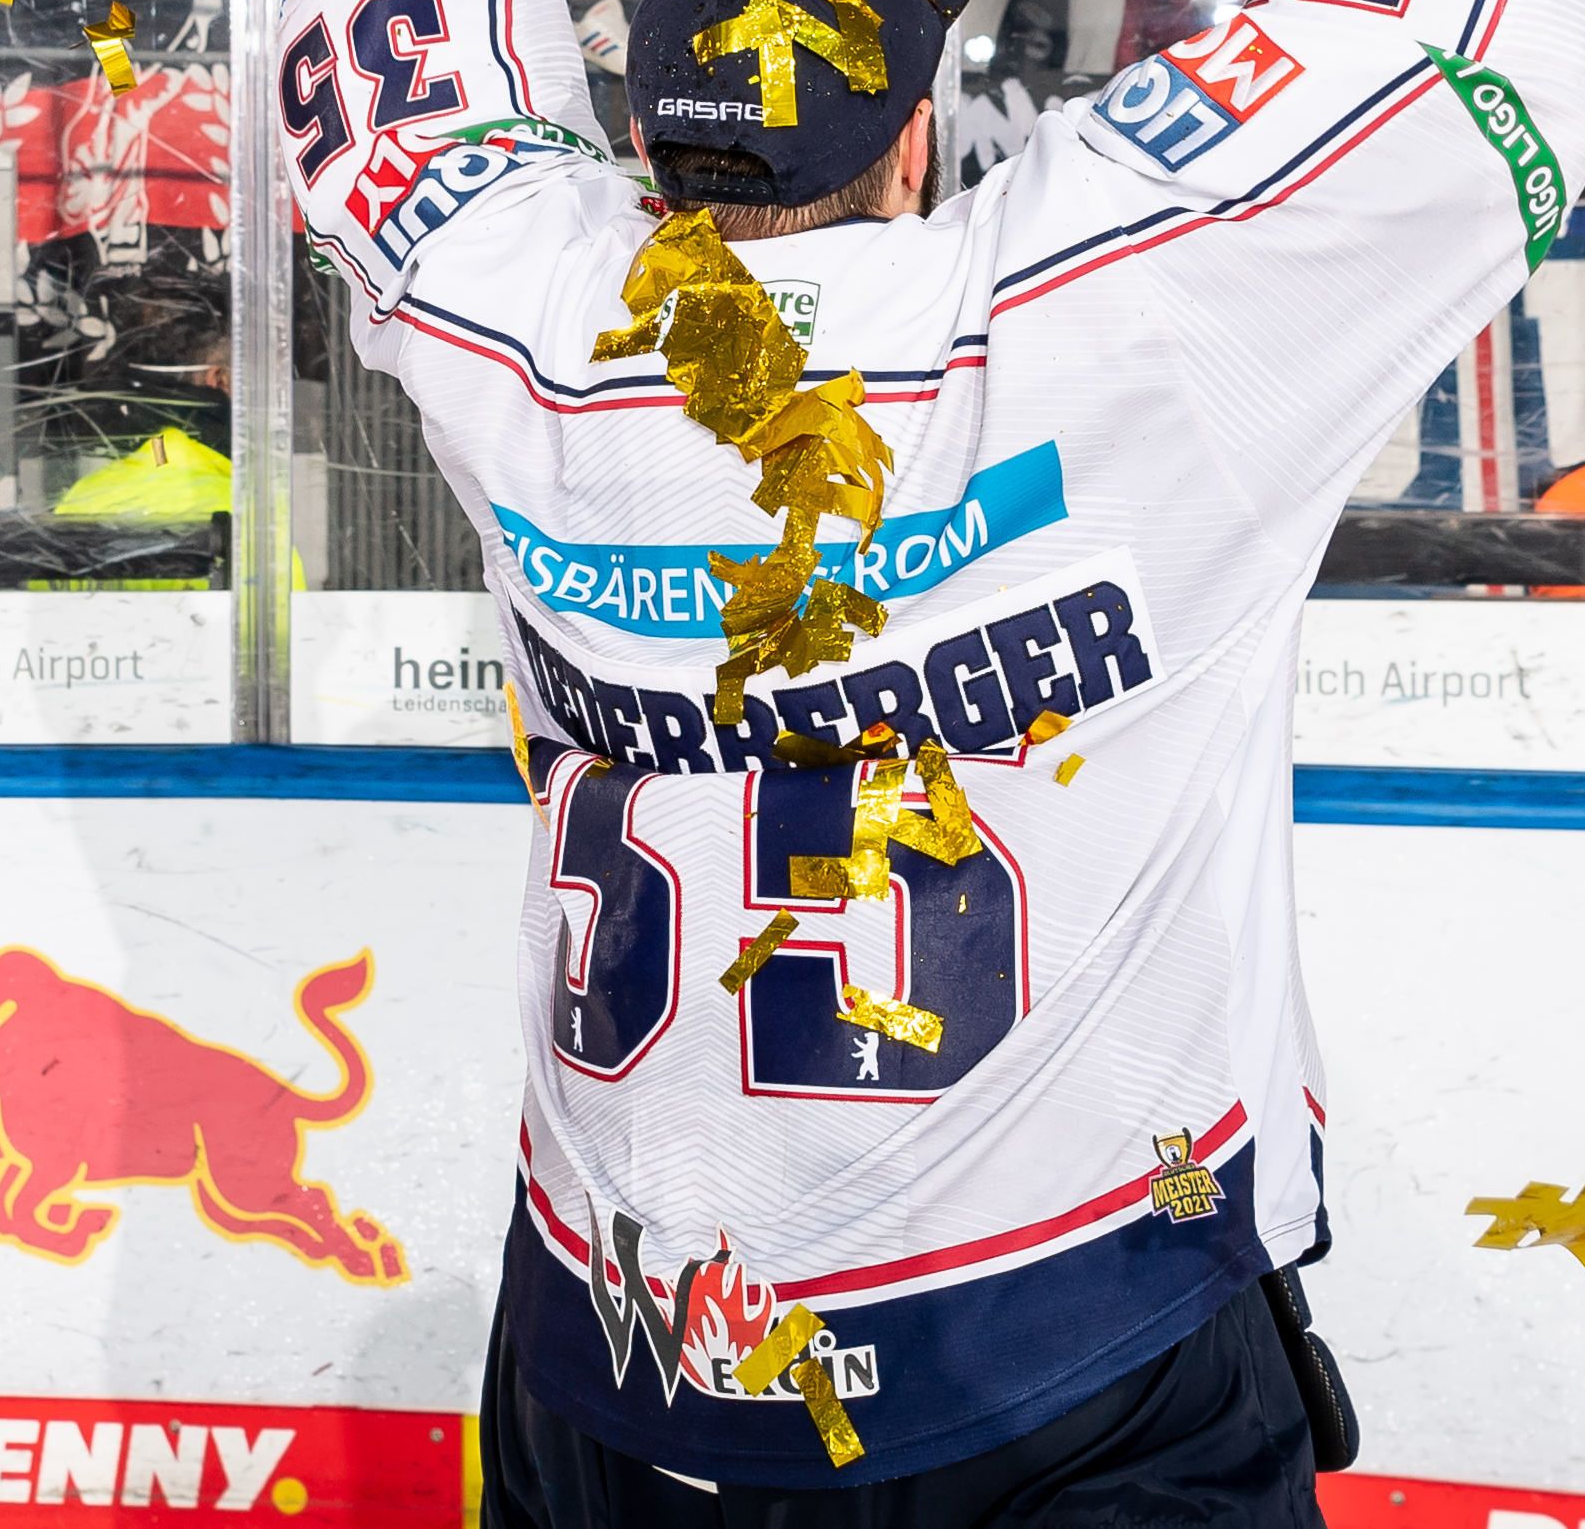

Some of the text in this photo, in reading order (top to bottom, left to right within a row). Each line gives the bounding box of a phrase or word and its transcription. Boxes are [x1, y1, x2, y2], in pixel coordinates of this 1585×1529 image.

[657, 98, 767, 121] GASAG
[1472, 83, 1540, 168] LIGO
[507, 528, 737, 622] ISBÄREN
[13, 647, 145, 689] Airport
[1380, 660, 1532, 708] Airport
[1152, 1169, 1219, 1209] MEISTER
[1171, 1194, 1213, 1219] 2021
